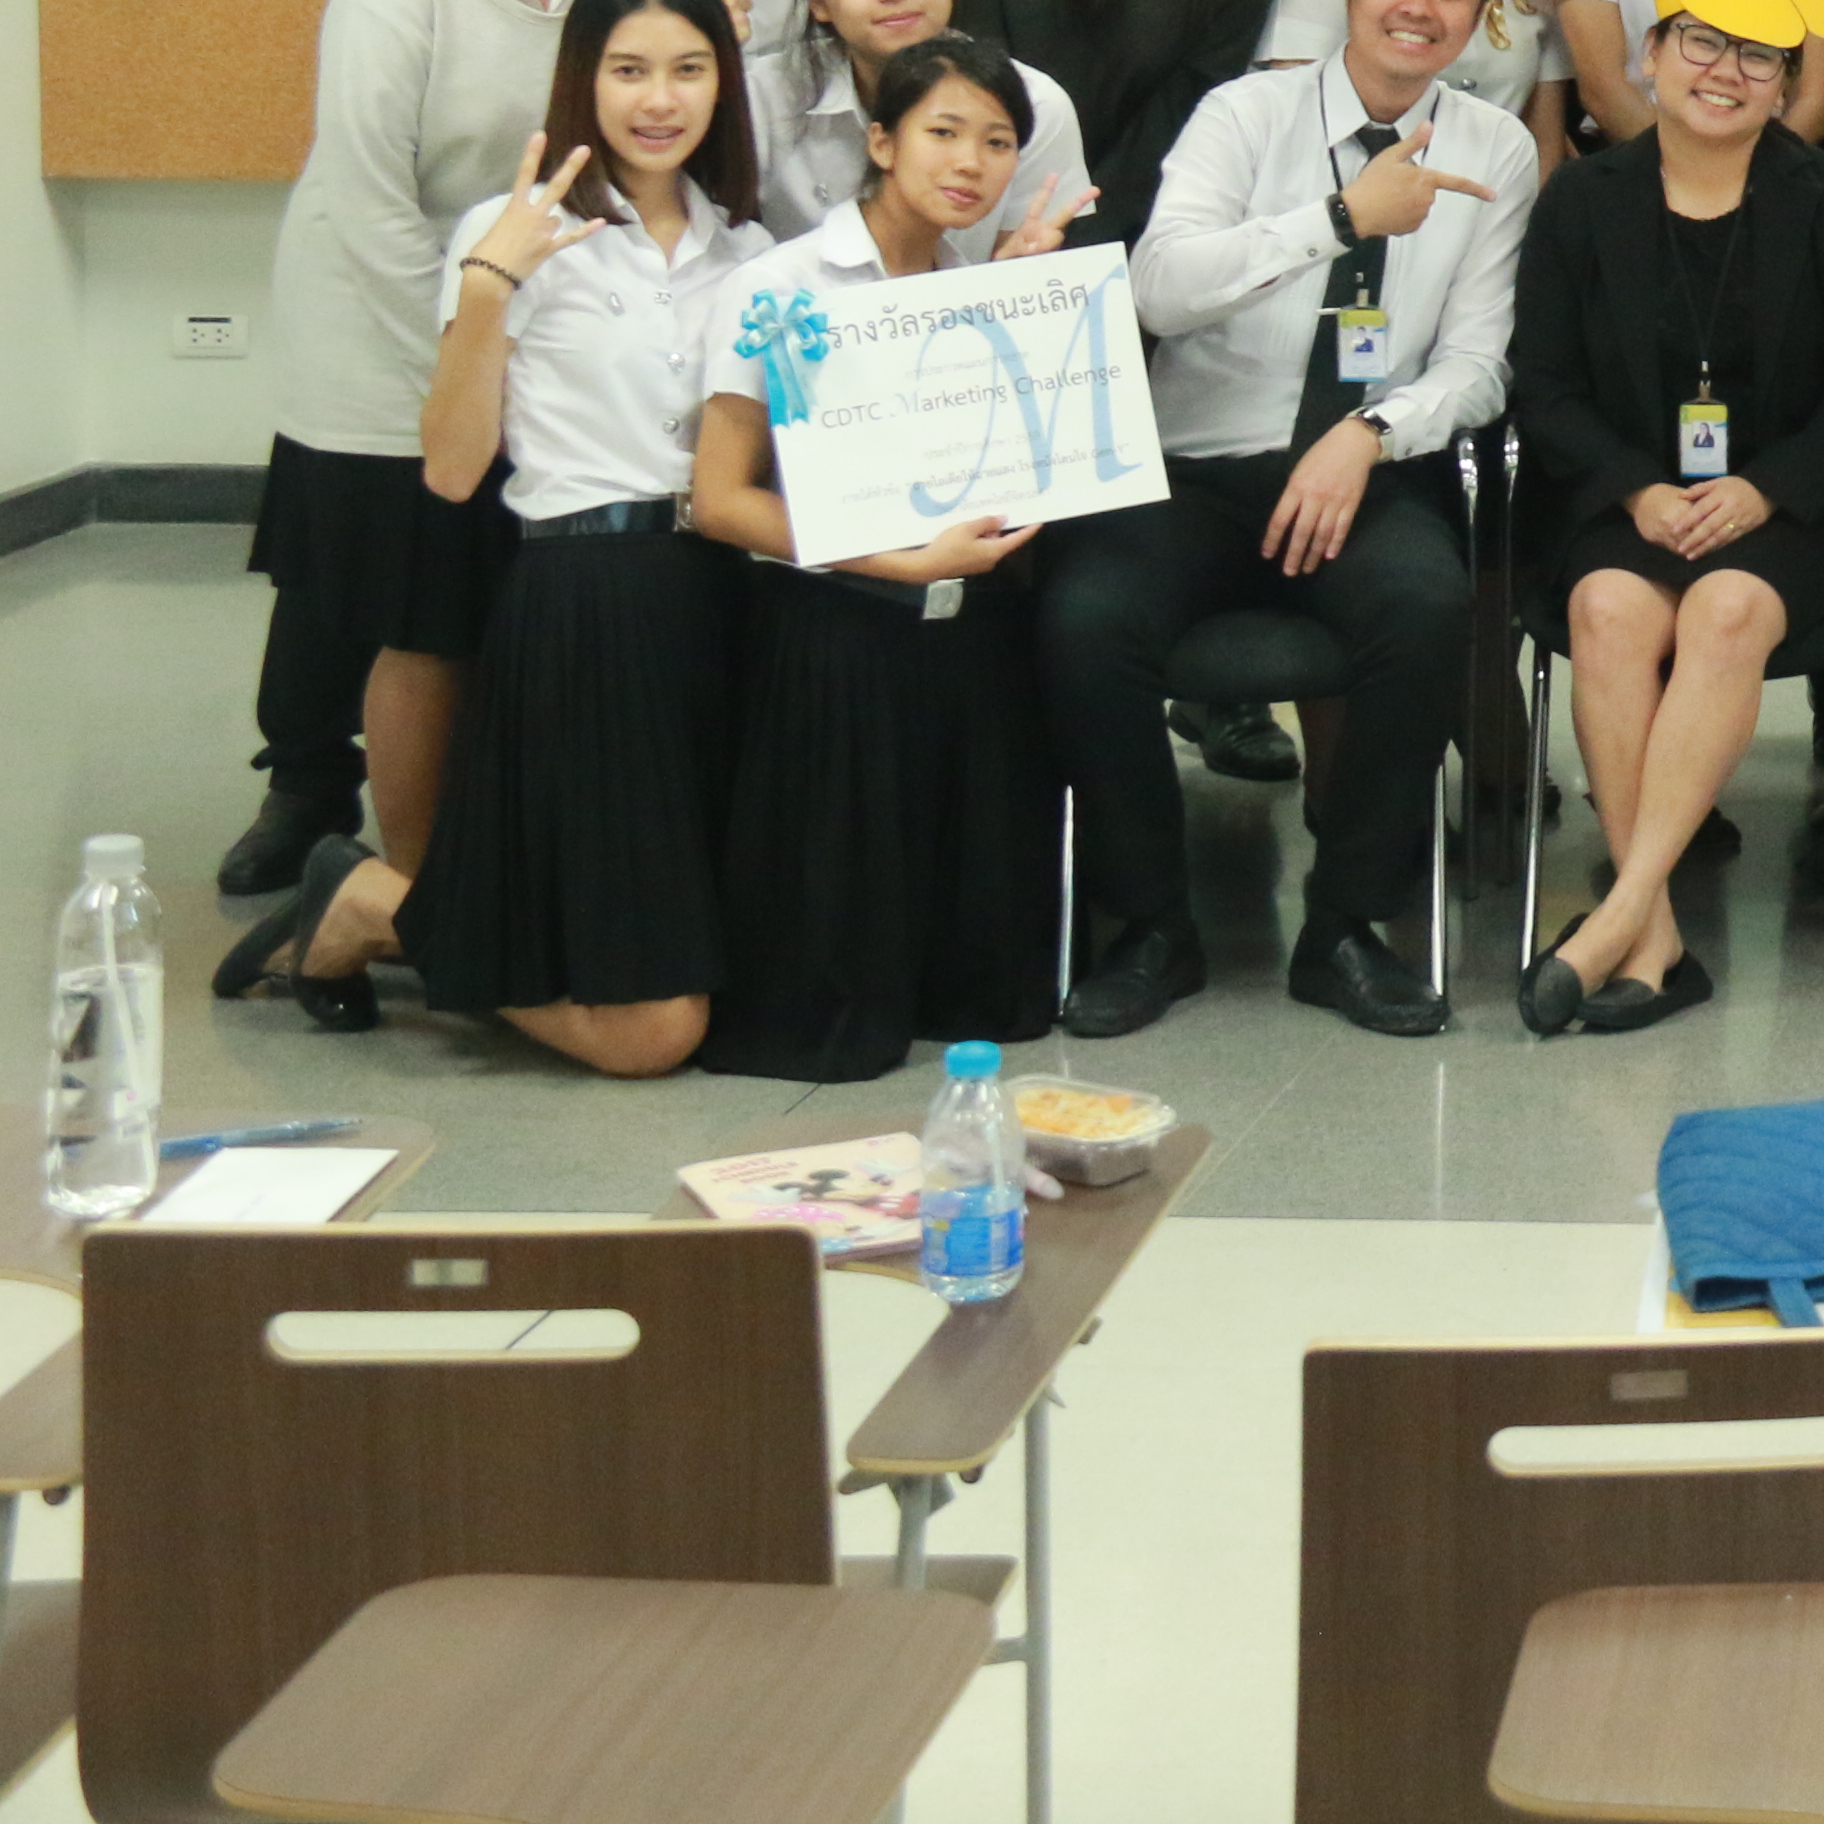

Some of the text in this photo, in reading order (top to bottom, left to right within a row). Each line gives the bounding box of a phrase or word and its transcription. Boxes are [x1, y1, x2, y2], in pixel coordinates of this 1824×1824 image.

[826, 278, 1091, 350] รางวัลรองชนะเลิศ
[821, 402, 884, 430] CDTC
[889, 384, 1009, 418] Marketing
[1015, 364, 1122, 396] Challenge
